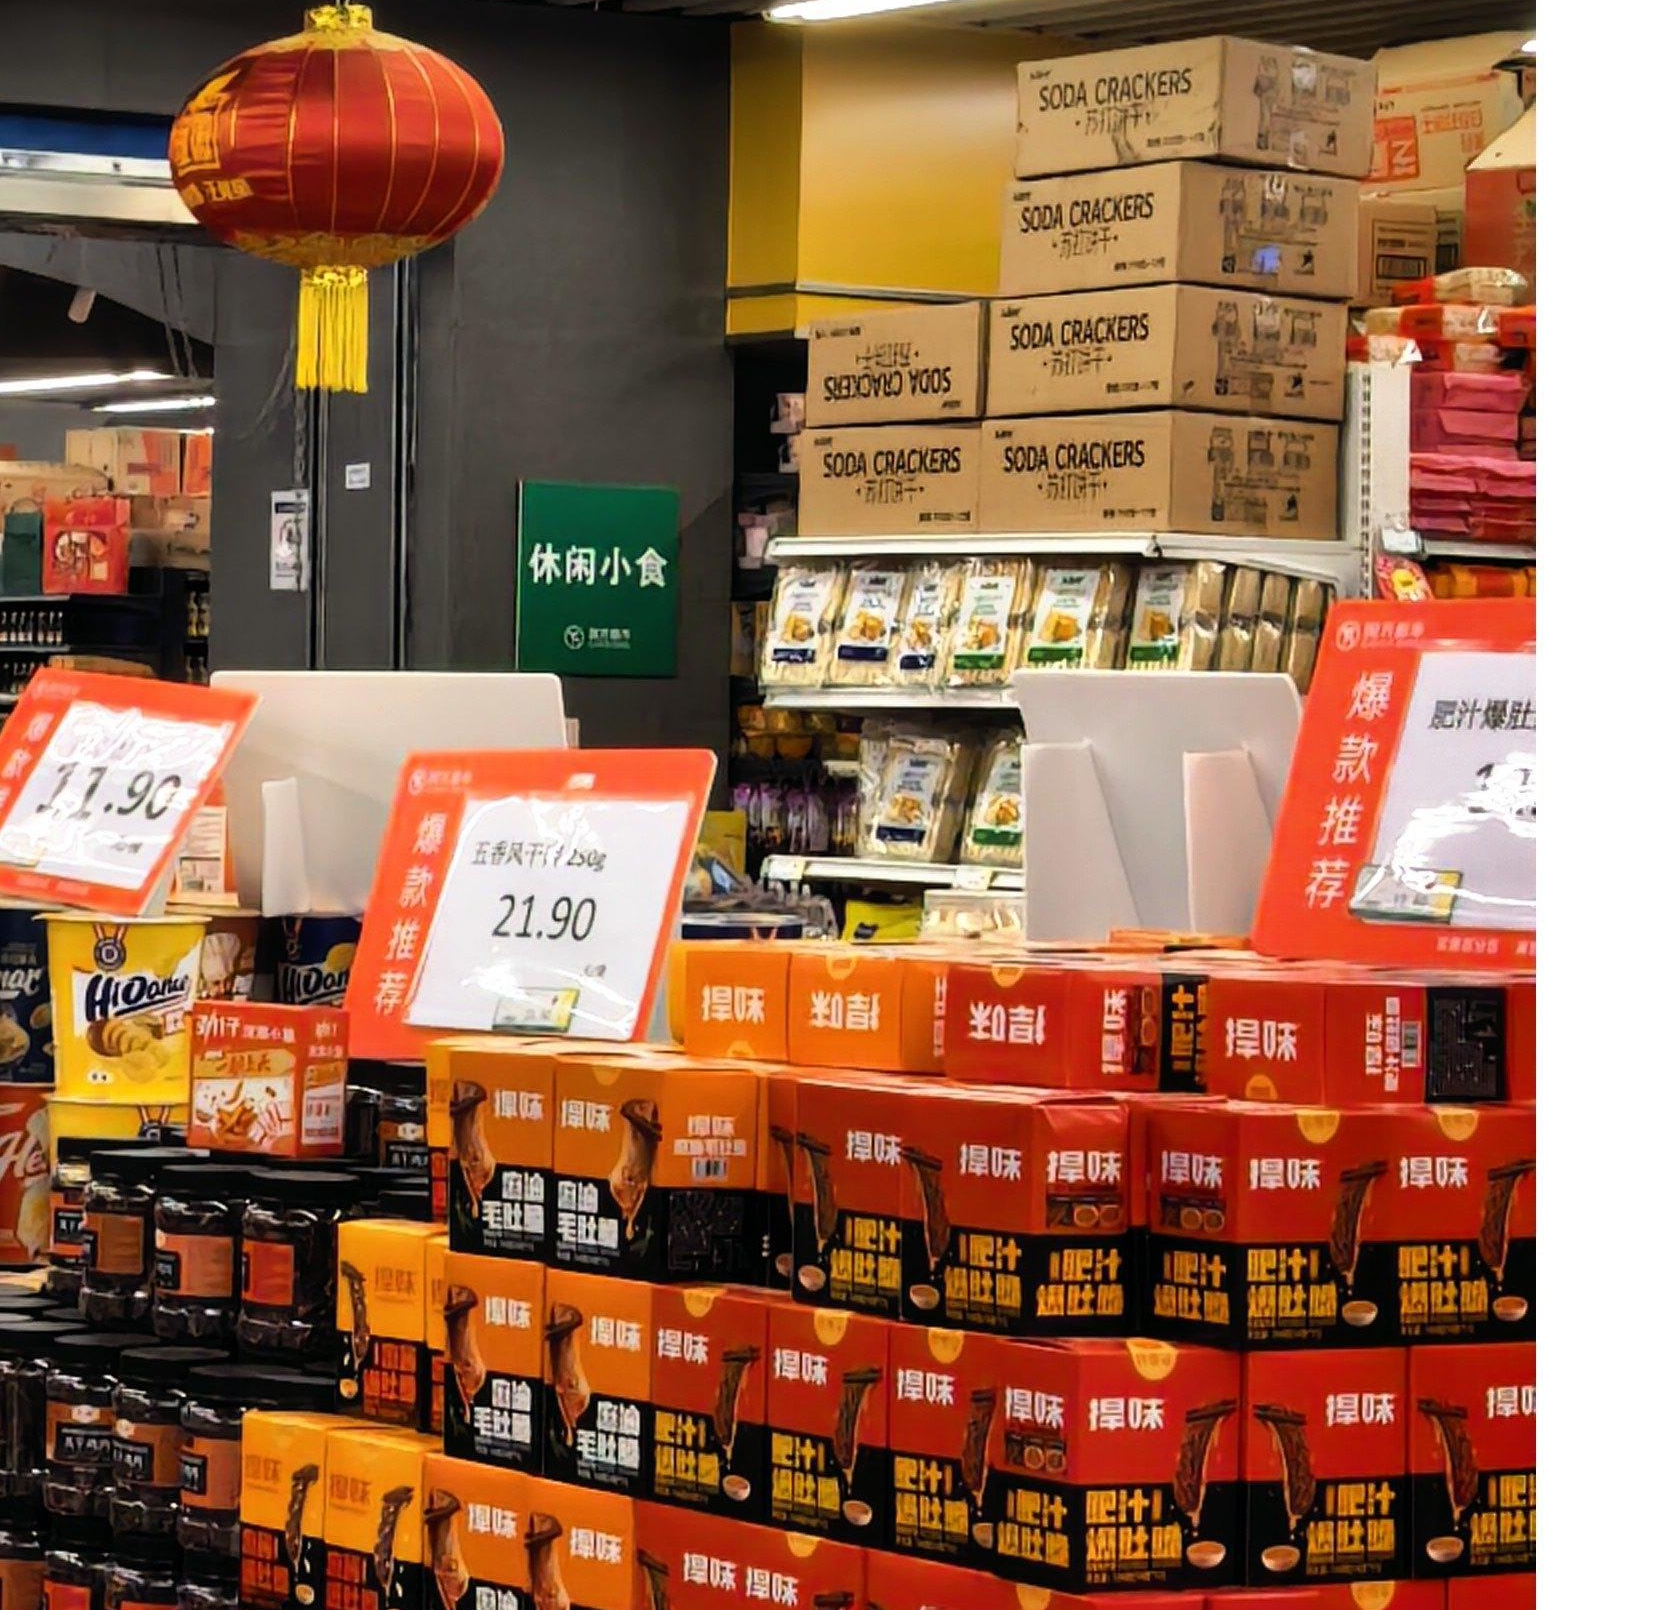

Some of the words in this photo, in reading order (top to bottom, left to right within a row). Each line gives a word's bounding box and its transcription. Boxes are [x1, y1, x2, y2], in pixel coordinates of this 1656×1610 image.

[1038, 81, 1088, 112] SODA
[1094, 67, 1193, 106] CRACKERS
[1020, 202, 1064, 234] SODA
[1069, 191, 1155, 227] CRACKERS
[1009, 322, 1054, 351] SODA
[1060, 312, 1150, 347] CRACKERS
[823, 371, 904, 402] CRACKERS
[908, 366, 952, 395] SODA
[823, 452, 868, 479] SODA
[873, 446, 962, 476] CRACKERS
[1003, 445, 1049, 473] SODA
[1055, 440, 1145, 470] CRACKERS
[528, 542, 668, 588] 休闲小食
[35, 761, 183, 822] 11.90
[1304, 669, 1395, 910] 爆款推荐
[491, 894, 597, 941] 21.90
